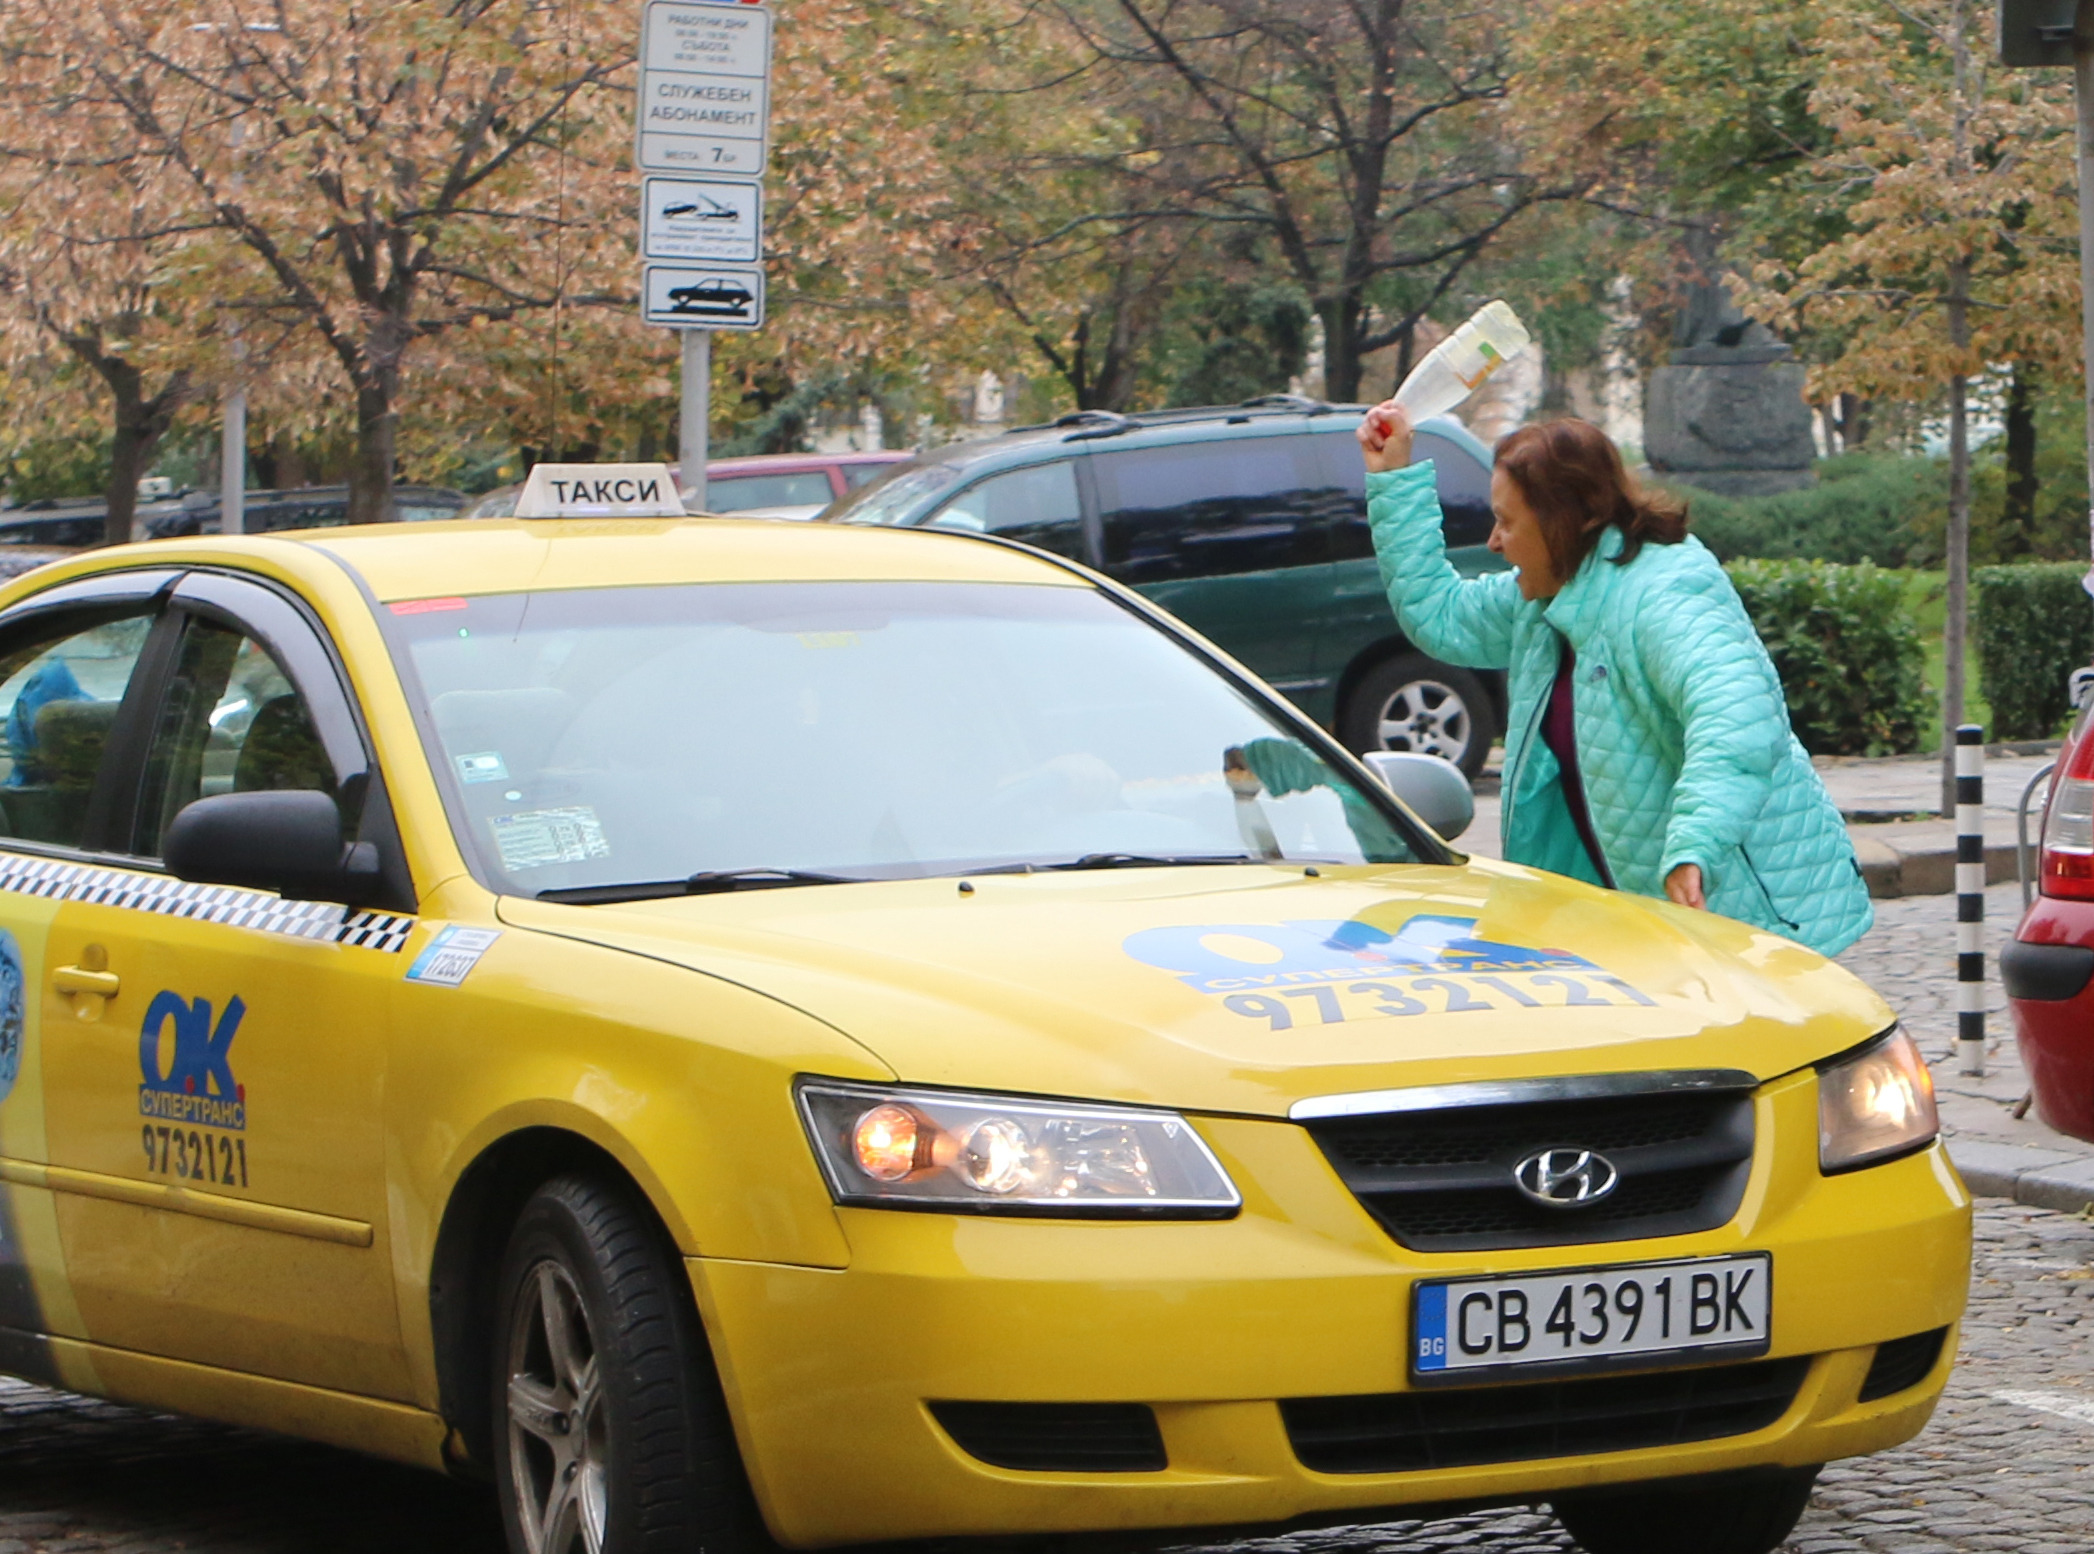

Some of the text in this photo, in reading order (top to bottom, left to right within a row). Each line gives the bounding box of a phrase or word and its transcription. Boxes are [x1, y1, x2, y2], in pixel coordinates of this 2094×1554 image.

[658, 83, 751, 101] СЛУЖЕБЕН
[650, 106, 756, 124] АБОНАМЕНТ
[711, 147, 723, 162] 7
[551, 479, 660, 503] ТАКСИ
[1204, 960, 1583, 989] СУПЕРТРАНС
[1223, 974, 1660, 1031] 9732121
[140, 1088, 245, 1128] СУПЕРТРАНС
[142, 1124, 248, 1188] 9732121
[1545, 1277, 1672, 1348] 4391
[1690, 1267, 1755, 1336] BK
[1419, 1337, 1444, 1357] BG
